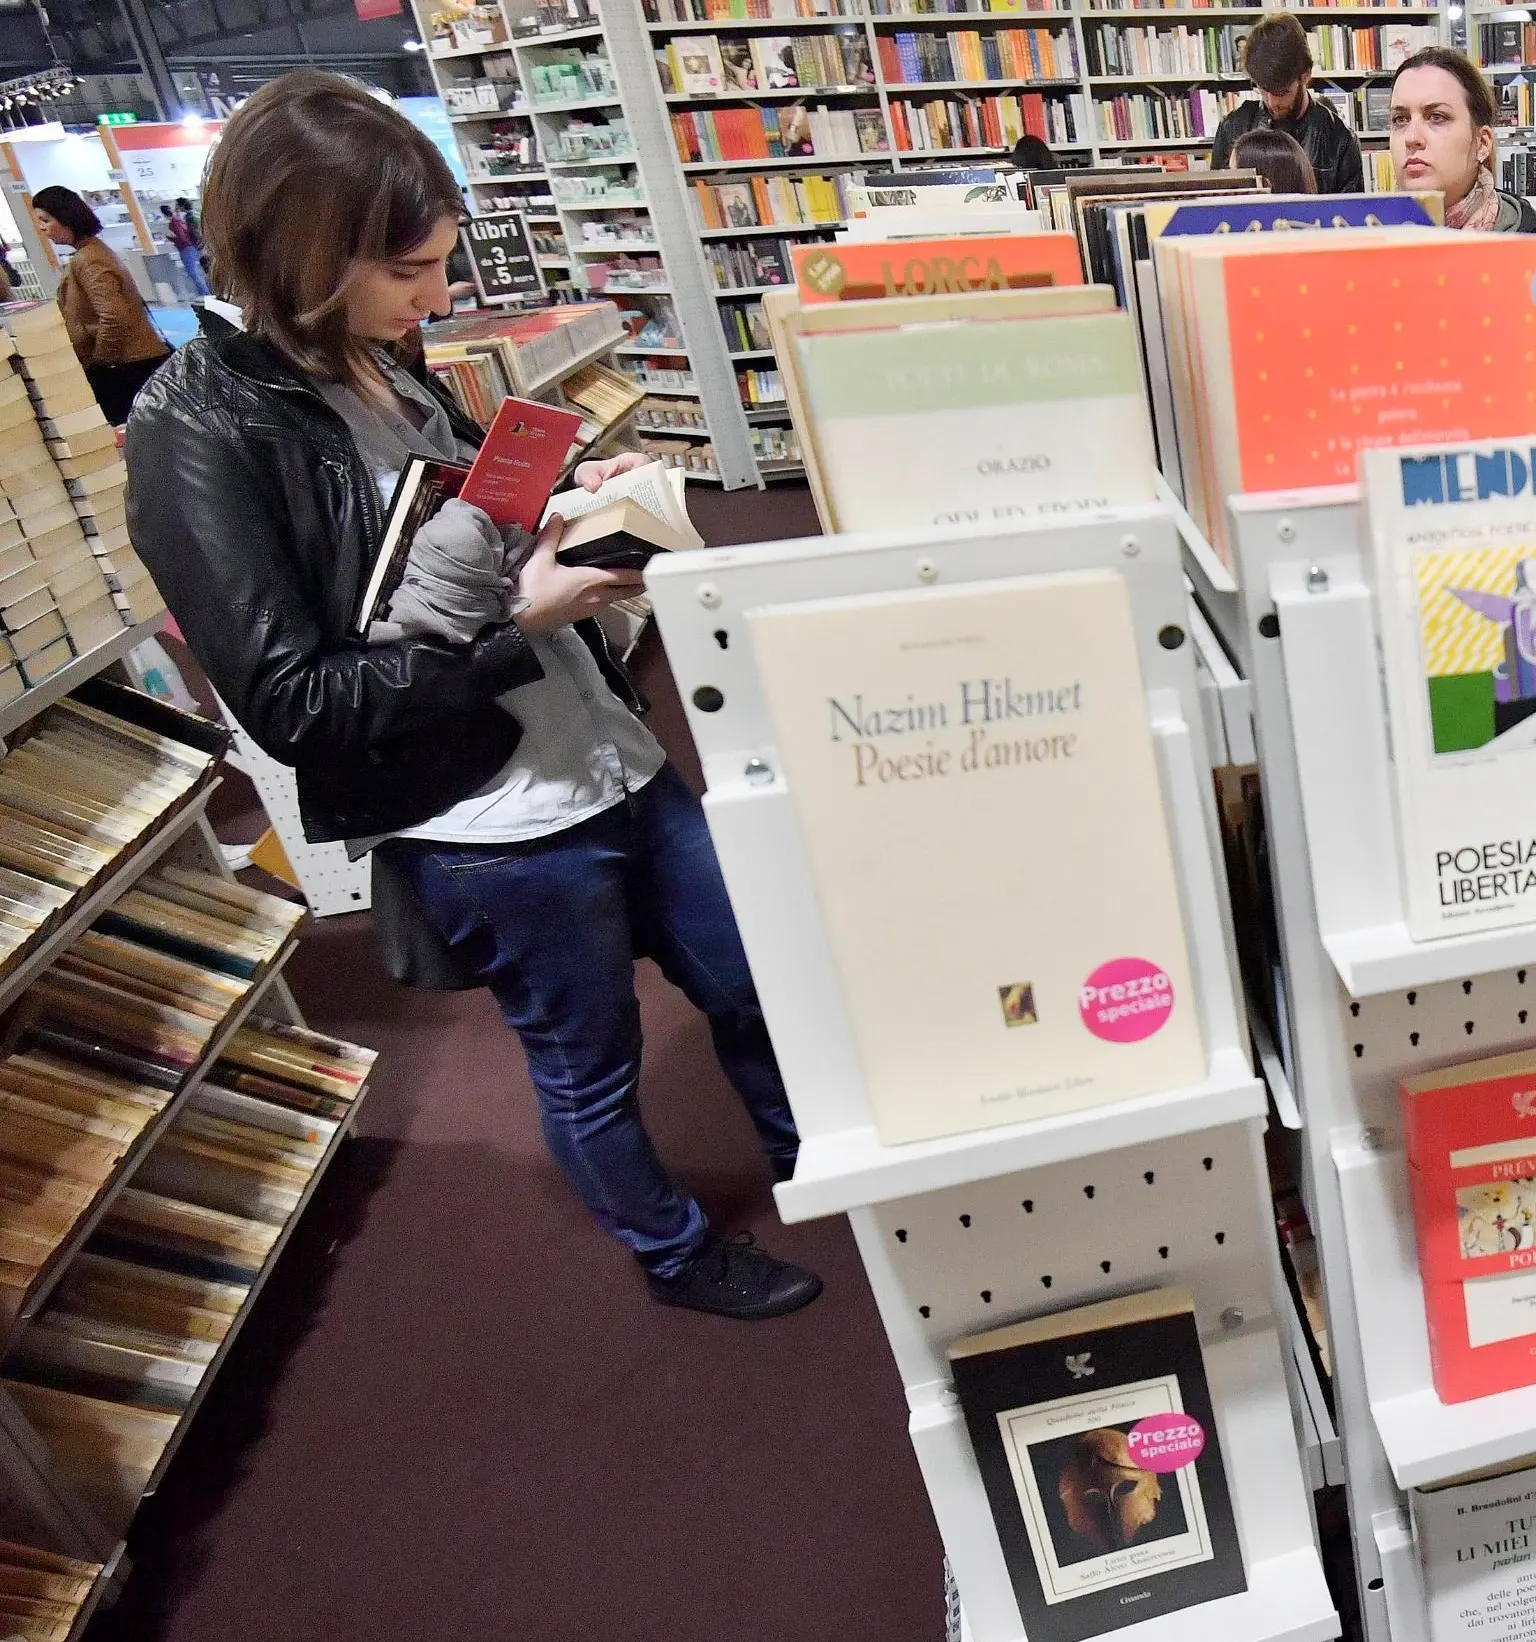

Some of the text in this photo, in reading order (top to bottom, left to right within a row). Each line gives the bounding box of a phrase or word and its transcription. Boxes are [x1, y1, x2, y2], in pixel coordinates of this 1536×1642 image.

[470, 219, 518, 241] libri
[491, 246, 506, 265] 3
[498, 267, 512, 285] 5
[881, 254, 1008, 295] LORCA
[977, 453, 1051, 477] ORAZIO
[827, 676, 1083, 743] Nazim Hikmet
[852, 728, 1078, 789] Poesie d'amore
[1080, 971, 1168, 1009] Prezzo
[1096, 991, 1172, 1024] speciale
[1127, 1423, 1201, 1448] Prezzo
[1141, 1437, 1201, 1459] speciale
[1471, 1495, 1523, 1514] Brandolini
[1456, 1546, 1476, 1563] LI
[1483, 1534, 1530, 1558] MIEI
[1491, 1551, 1532, 1571] parlan
[1119, 1589, 1153, 1606] Guanda
[1486, 1588, 1512, 1603] delle
[1458, 1608, 1482, 1620] che,
[1486, 1603, 1503, 1614] nel
[1467, 1616, 1485, 1629] dai
[1488, 1606, 1536, 1624] trovatori
